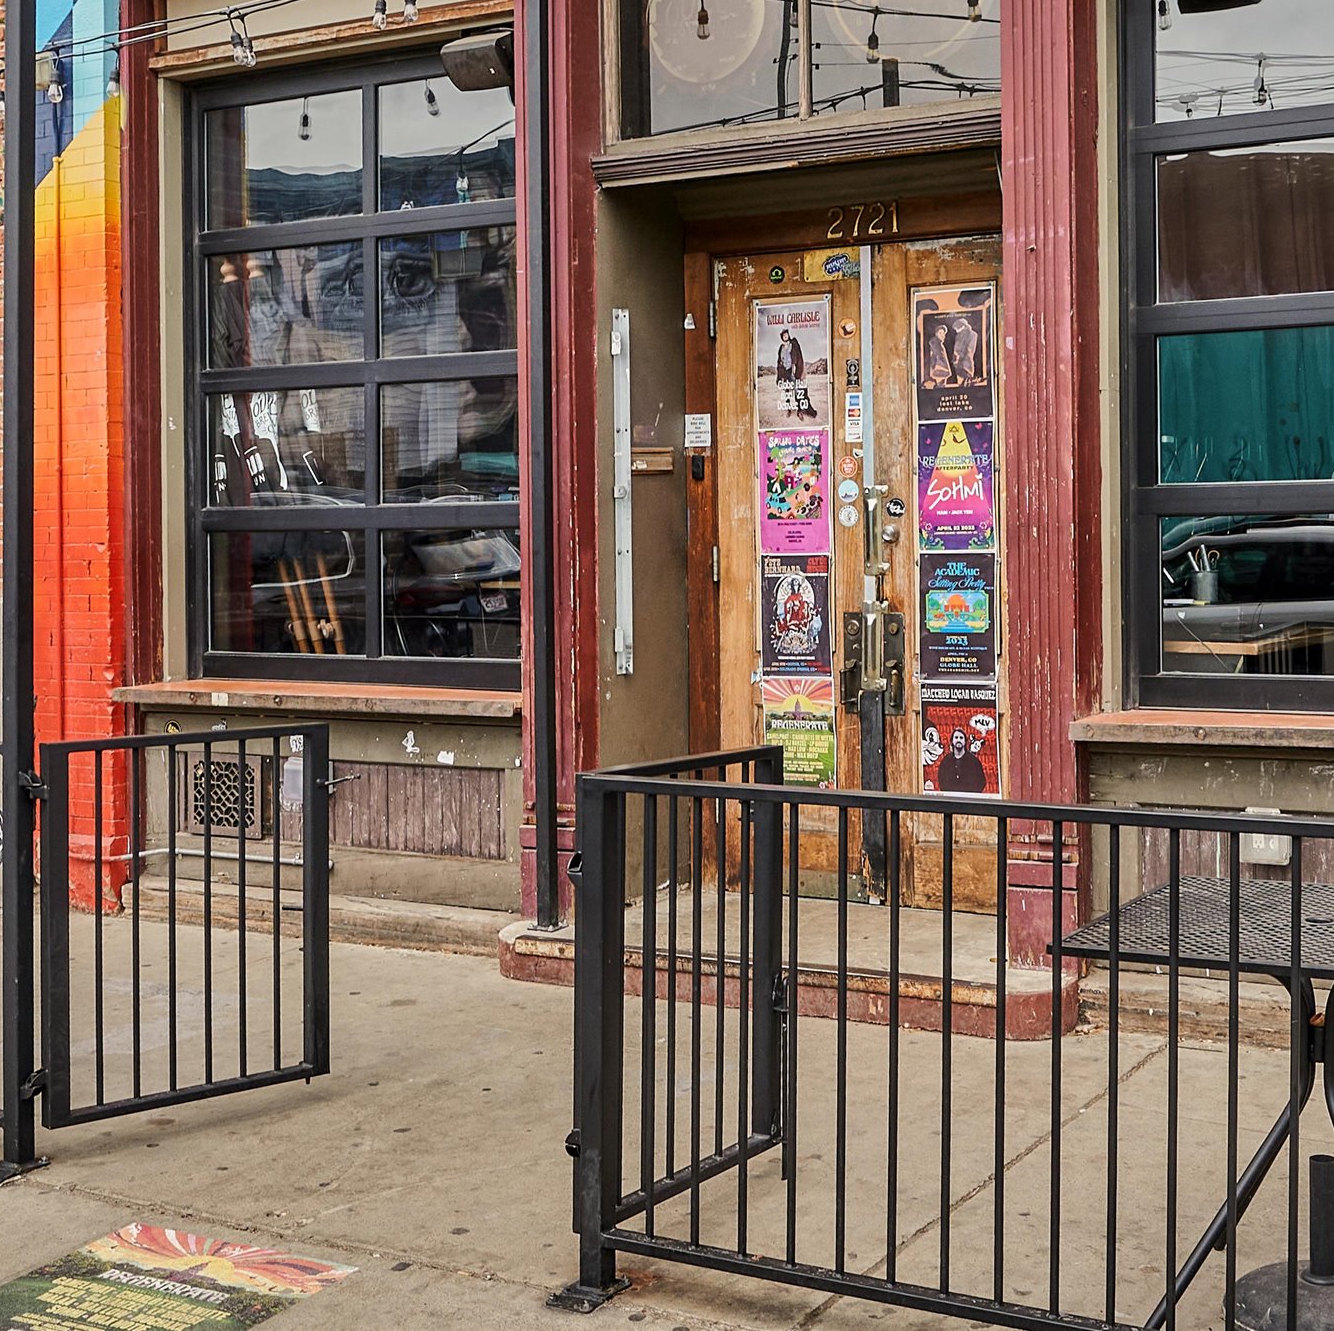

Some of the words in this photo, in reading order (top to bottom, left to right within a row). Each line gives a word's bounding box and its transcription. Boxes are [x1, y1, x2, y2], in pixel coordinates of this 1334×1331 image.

[826, 201, 901, 241] 2721
[923, 454, 988, 466] REGENERATE
[935, 568, 980, 576] ACADEMIC
[771, 719, 829, 730] REGENERATE
